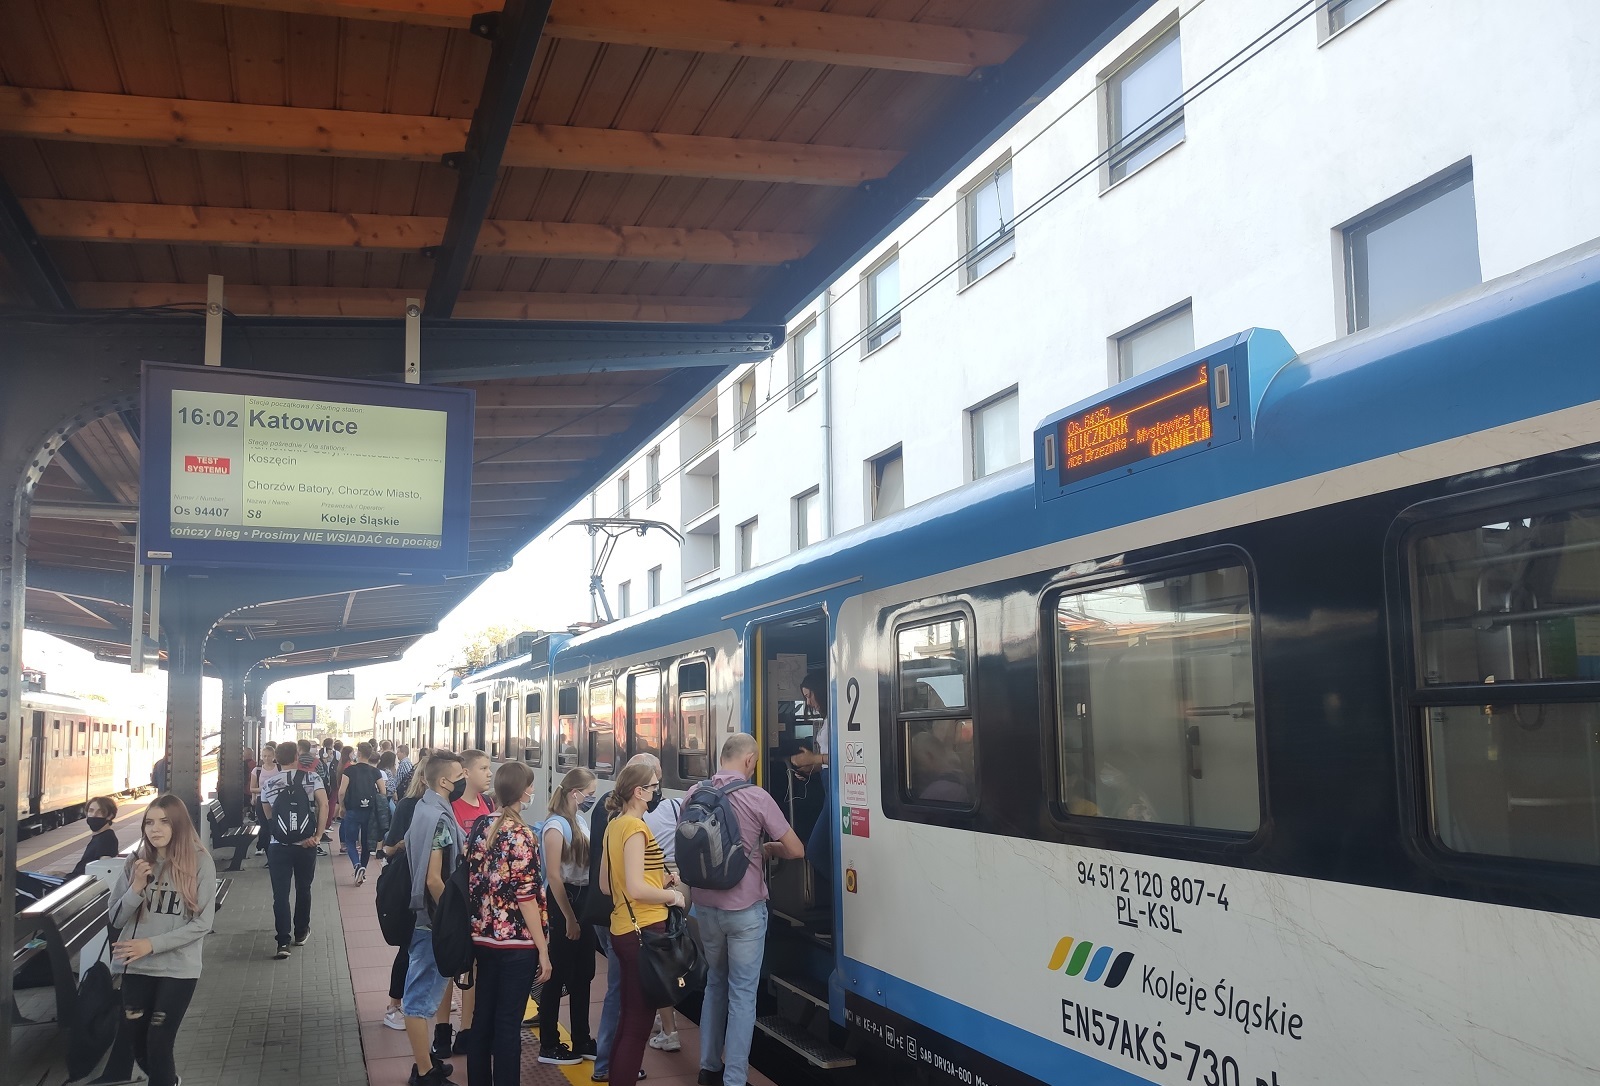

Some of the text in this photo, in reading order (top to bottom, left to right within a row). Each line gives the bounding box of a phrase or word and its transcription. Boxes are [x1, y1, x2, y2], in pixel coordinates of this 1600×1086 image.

[178, 407, 238, 428] 16:02
[316, 404, 340, 412] Starting
[249, 410, 358, 434] Katowice
[248, 439, 268, 447] Stacja
[187, 465, 228, 474] SYSTEMU
[197, 456, 218, 464] TEST
[248, 454, 297, 466] Koszęcin
[248, 480, 422, 500] Chorzów Batory, Chorzów Miasto,
[174, 506, 229, 517] Os 94407
[246, 510, 262, 519] S8
[321, 514, 400, 528] Koleje Śląskie
[214, 528, 240, 540] bieg
[251, 530, 300, 542] Prosimy
[302, 532, 323, 542] NIE
[326, 533, 382, 544] WSIADAĆ
[386, 536, 400, 545] do
[726, 690, 734, 732] 2
[846, 676, 860, 732] 2
[1077, 861, 1228, 911] 94 51 2 120 807-4
[1117, 896, 1182, 934] PL-KSL
[1142, 965, 1304, 1040] Koleje Śląskie
[1062, 998, 1240, 1086] EN57AKŚ-730
[920, 1047, 932, 1064] SAB
[934, 1054, 972, 1084] DRV3A-600
